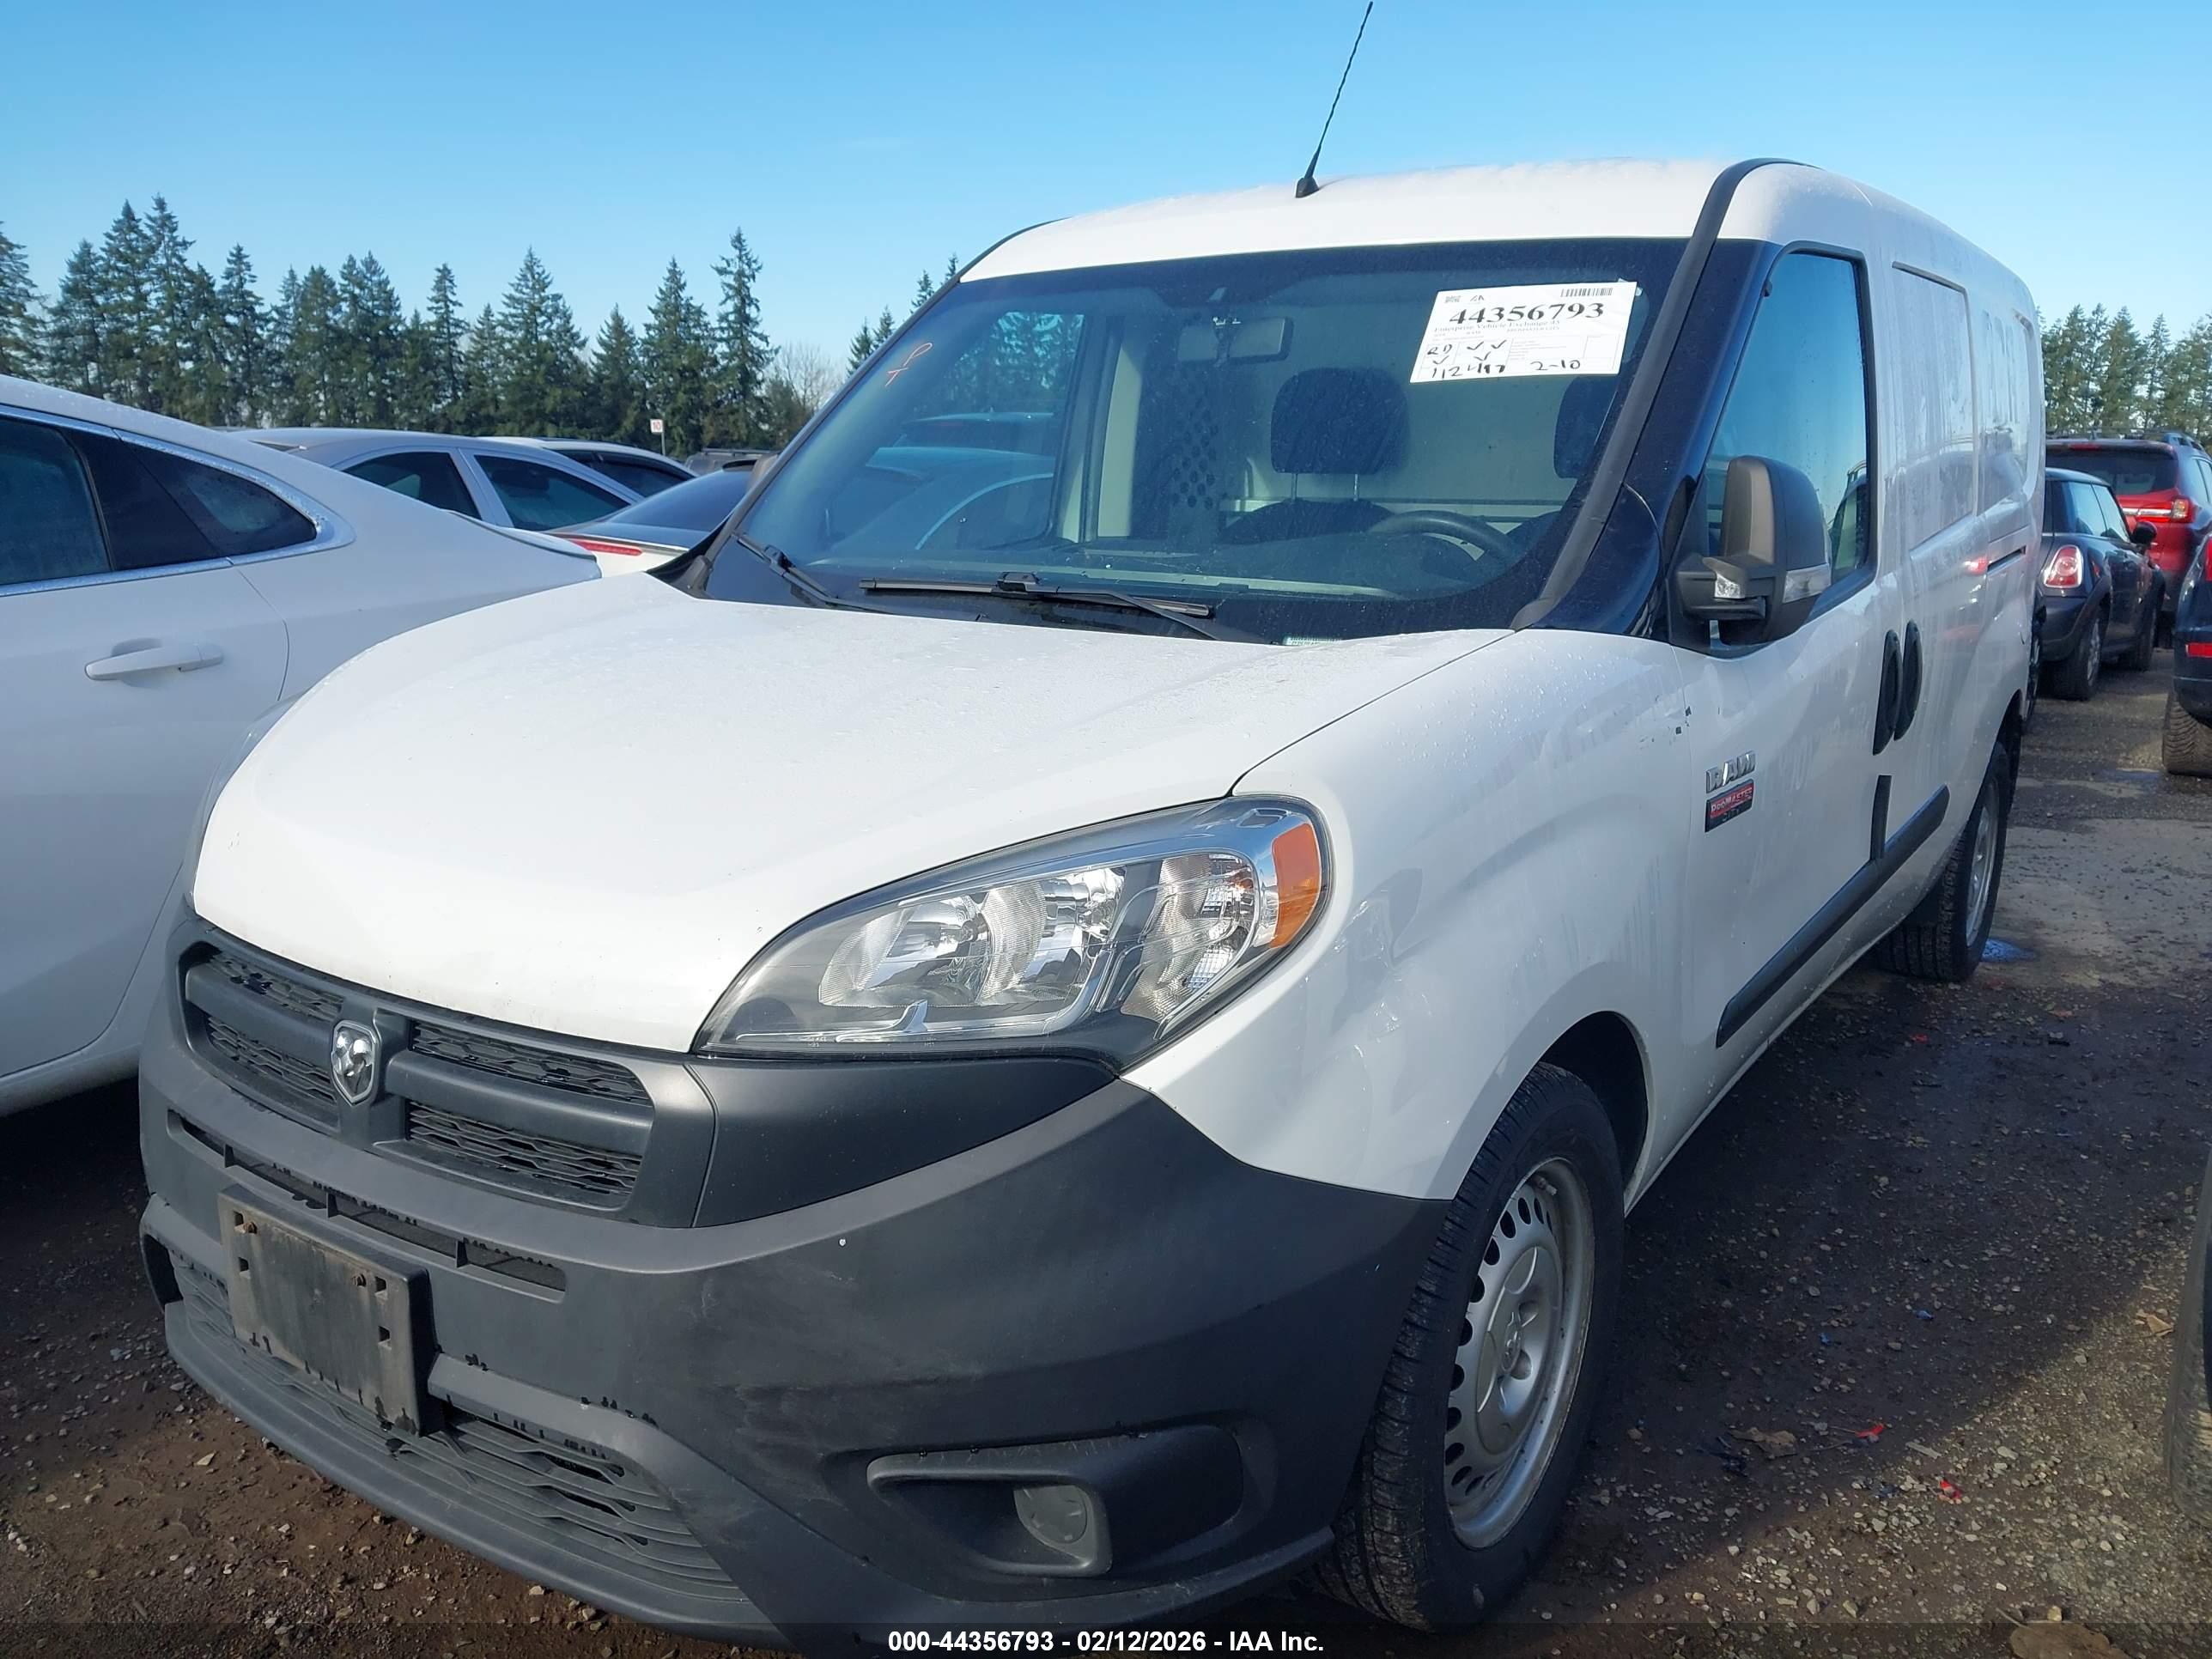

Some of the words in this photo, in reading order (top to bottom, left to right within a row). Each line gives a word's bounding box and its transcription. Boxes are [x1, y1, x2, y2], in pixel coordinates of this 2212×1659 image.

[1449, 302, 1604, 324] 44356793
[1530, 359, 1581, 371] 2-10
[1705, 750, 1756, 794] RAM
